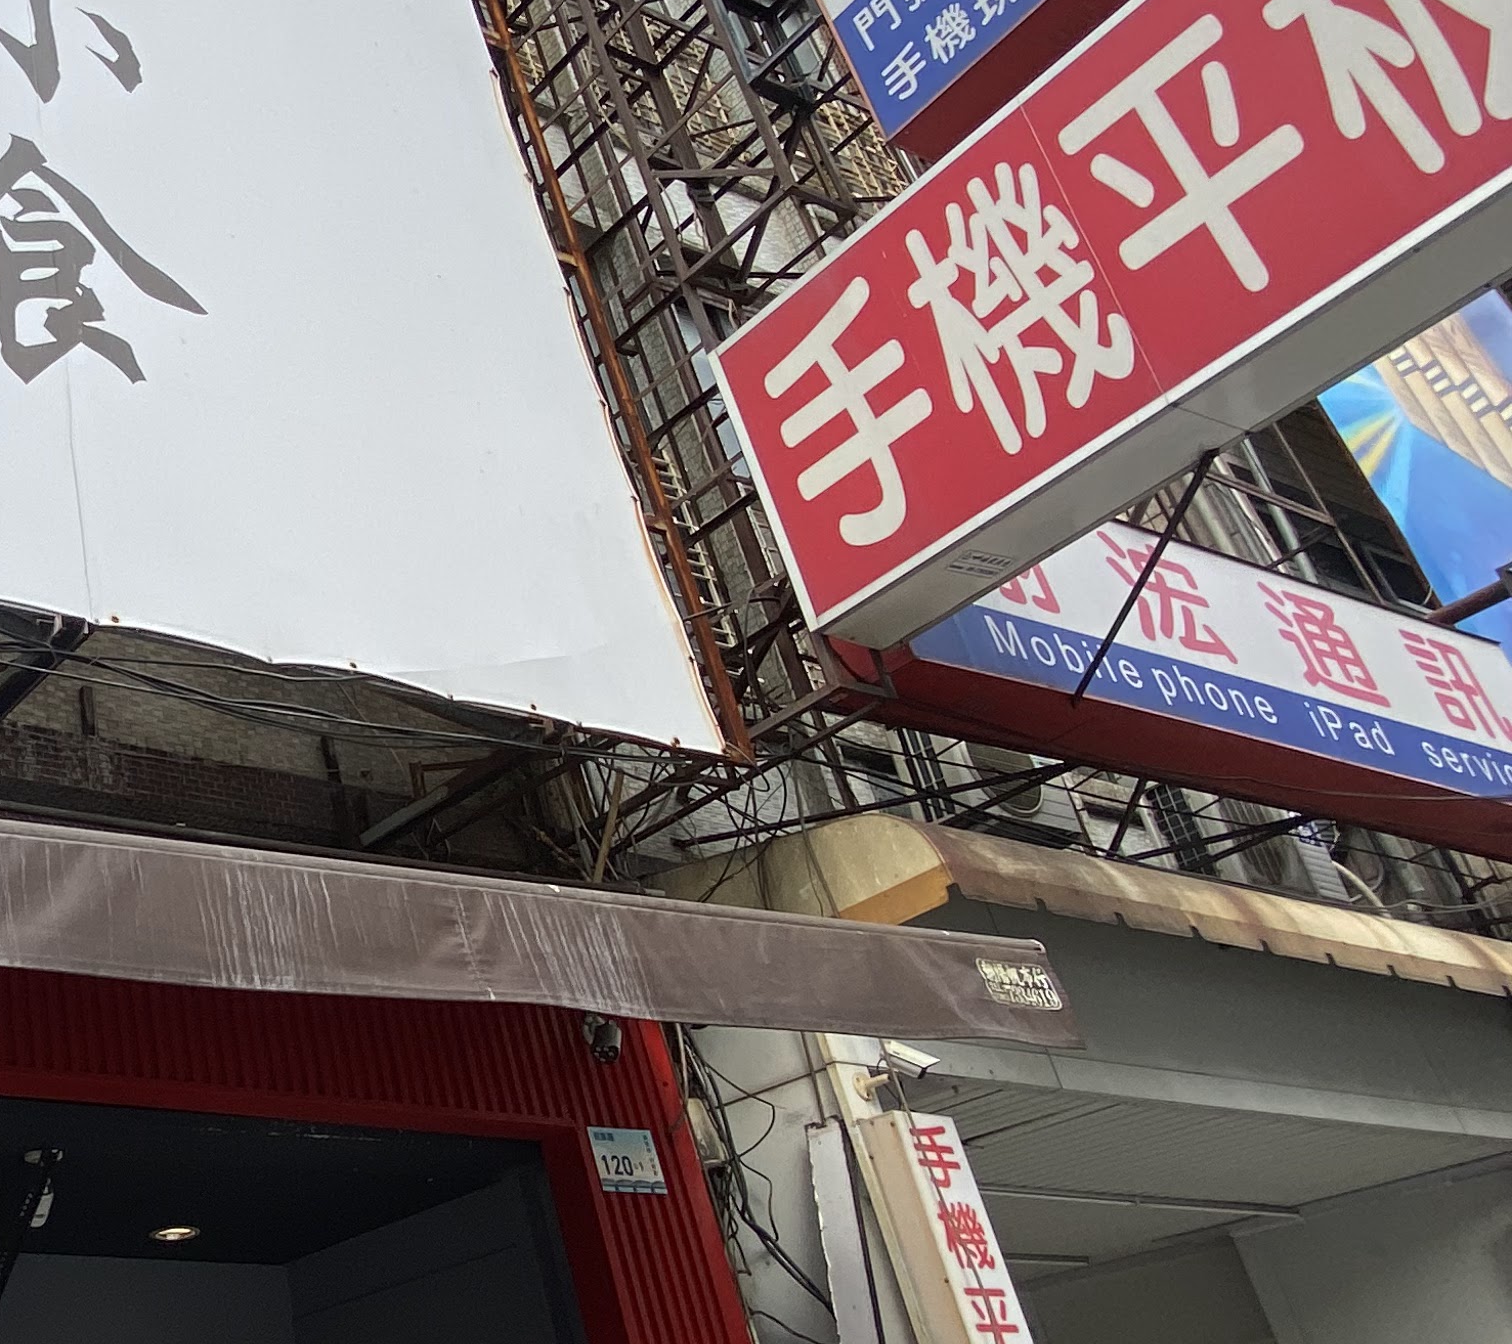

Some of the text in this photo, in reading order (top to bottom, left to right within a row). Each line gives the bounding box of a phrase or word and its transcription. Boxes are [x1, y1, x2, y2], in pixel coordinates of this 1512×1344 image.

[983, 613, 1144, 689] Mobile
[1150, 664, 1279, 725] phone
[1303, 701, 1396, 756] iPad
